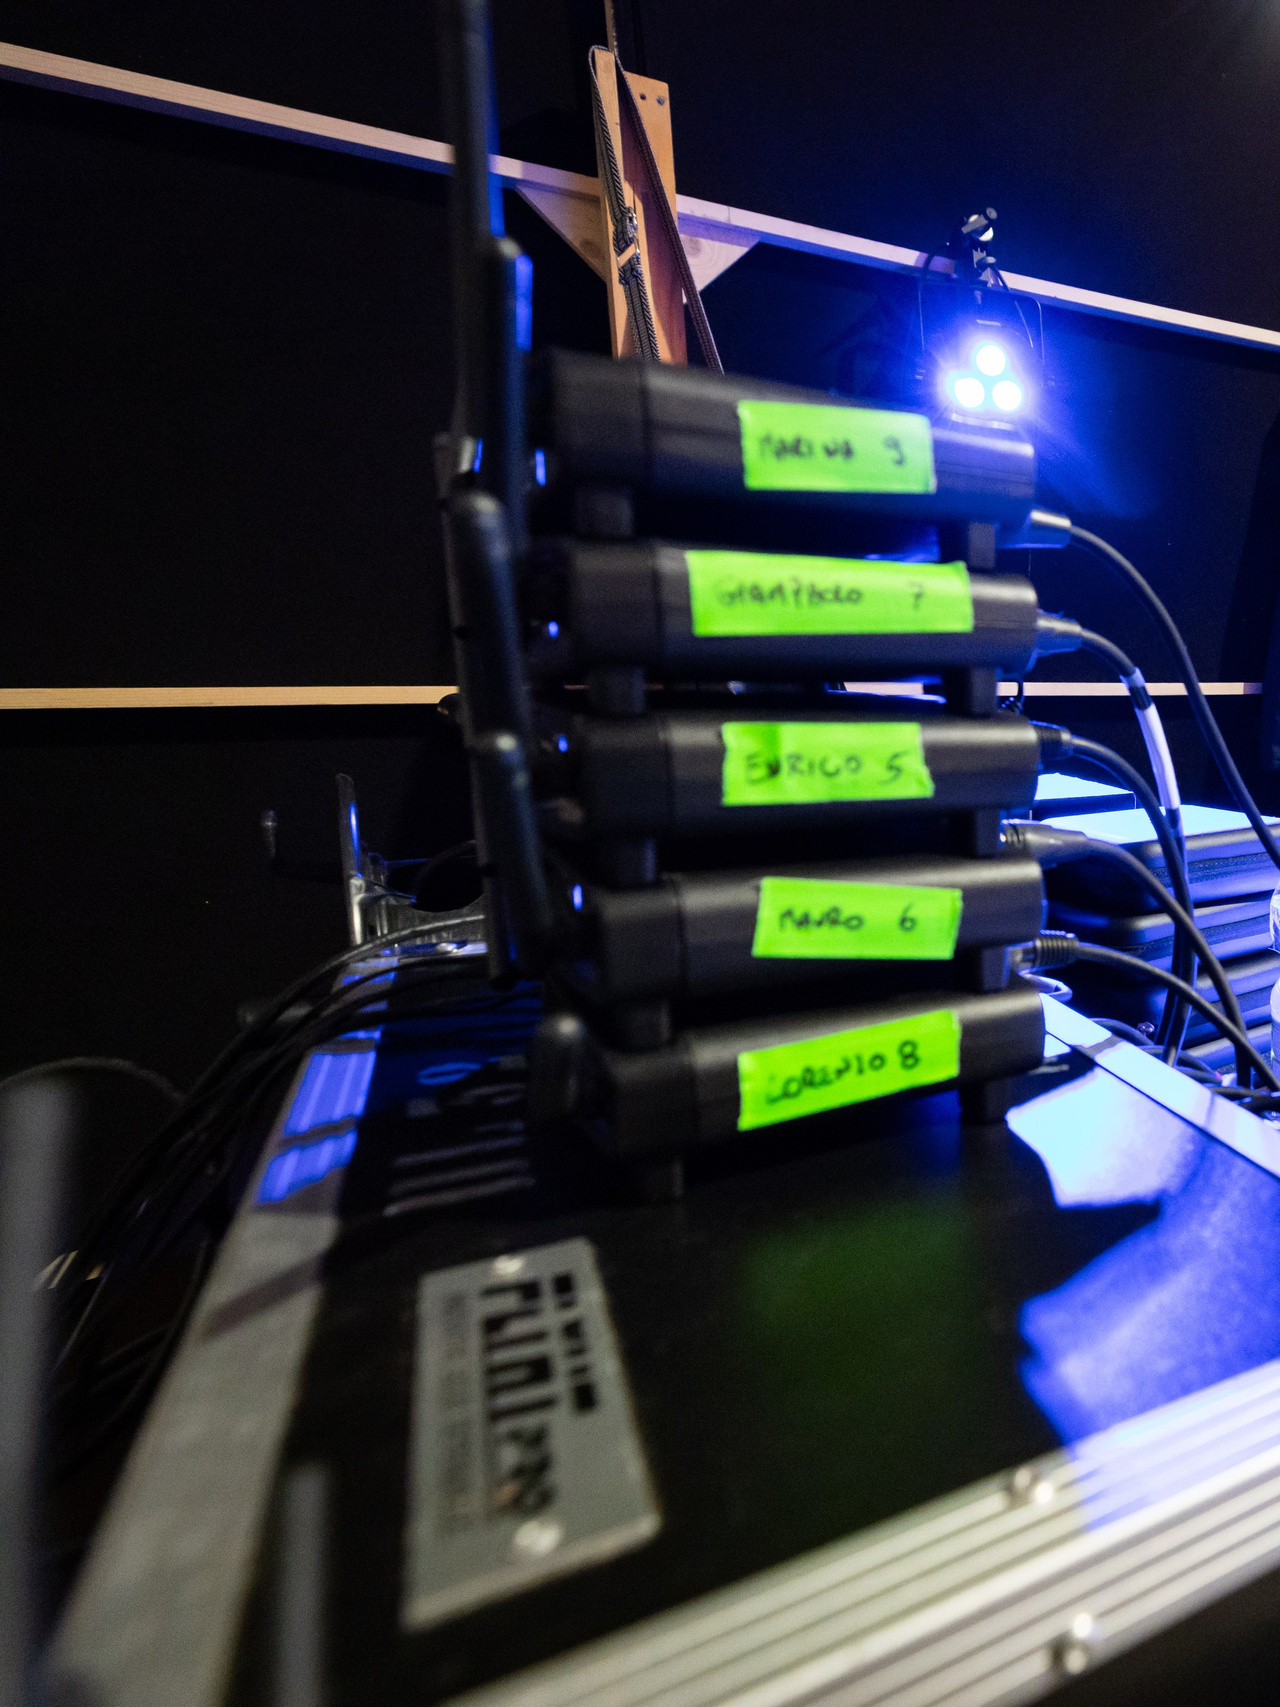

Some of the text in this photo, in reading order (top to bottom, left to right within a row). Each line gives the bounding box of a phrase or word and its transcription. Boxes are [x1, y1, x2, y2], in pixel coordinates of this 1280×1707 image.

[908, 581, 926, 611] 7
[745, 749, 910, 786] ENRICO 5
[898, 901, 918, 933] 6
[897, 1039, 921, 1071] 8
